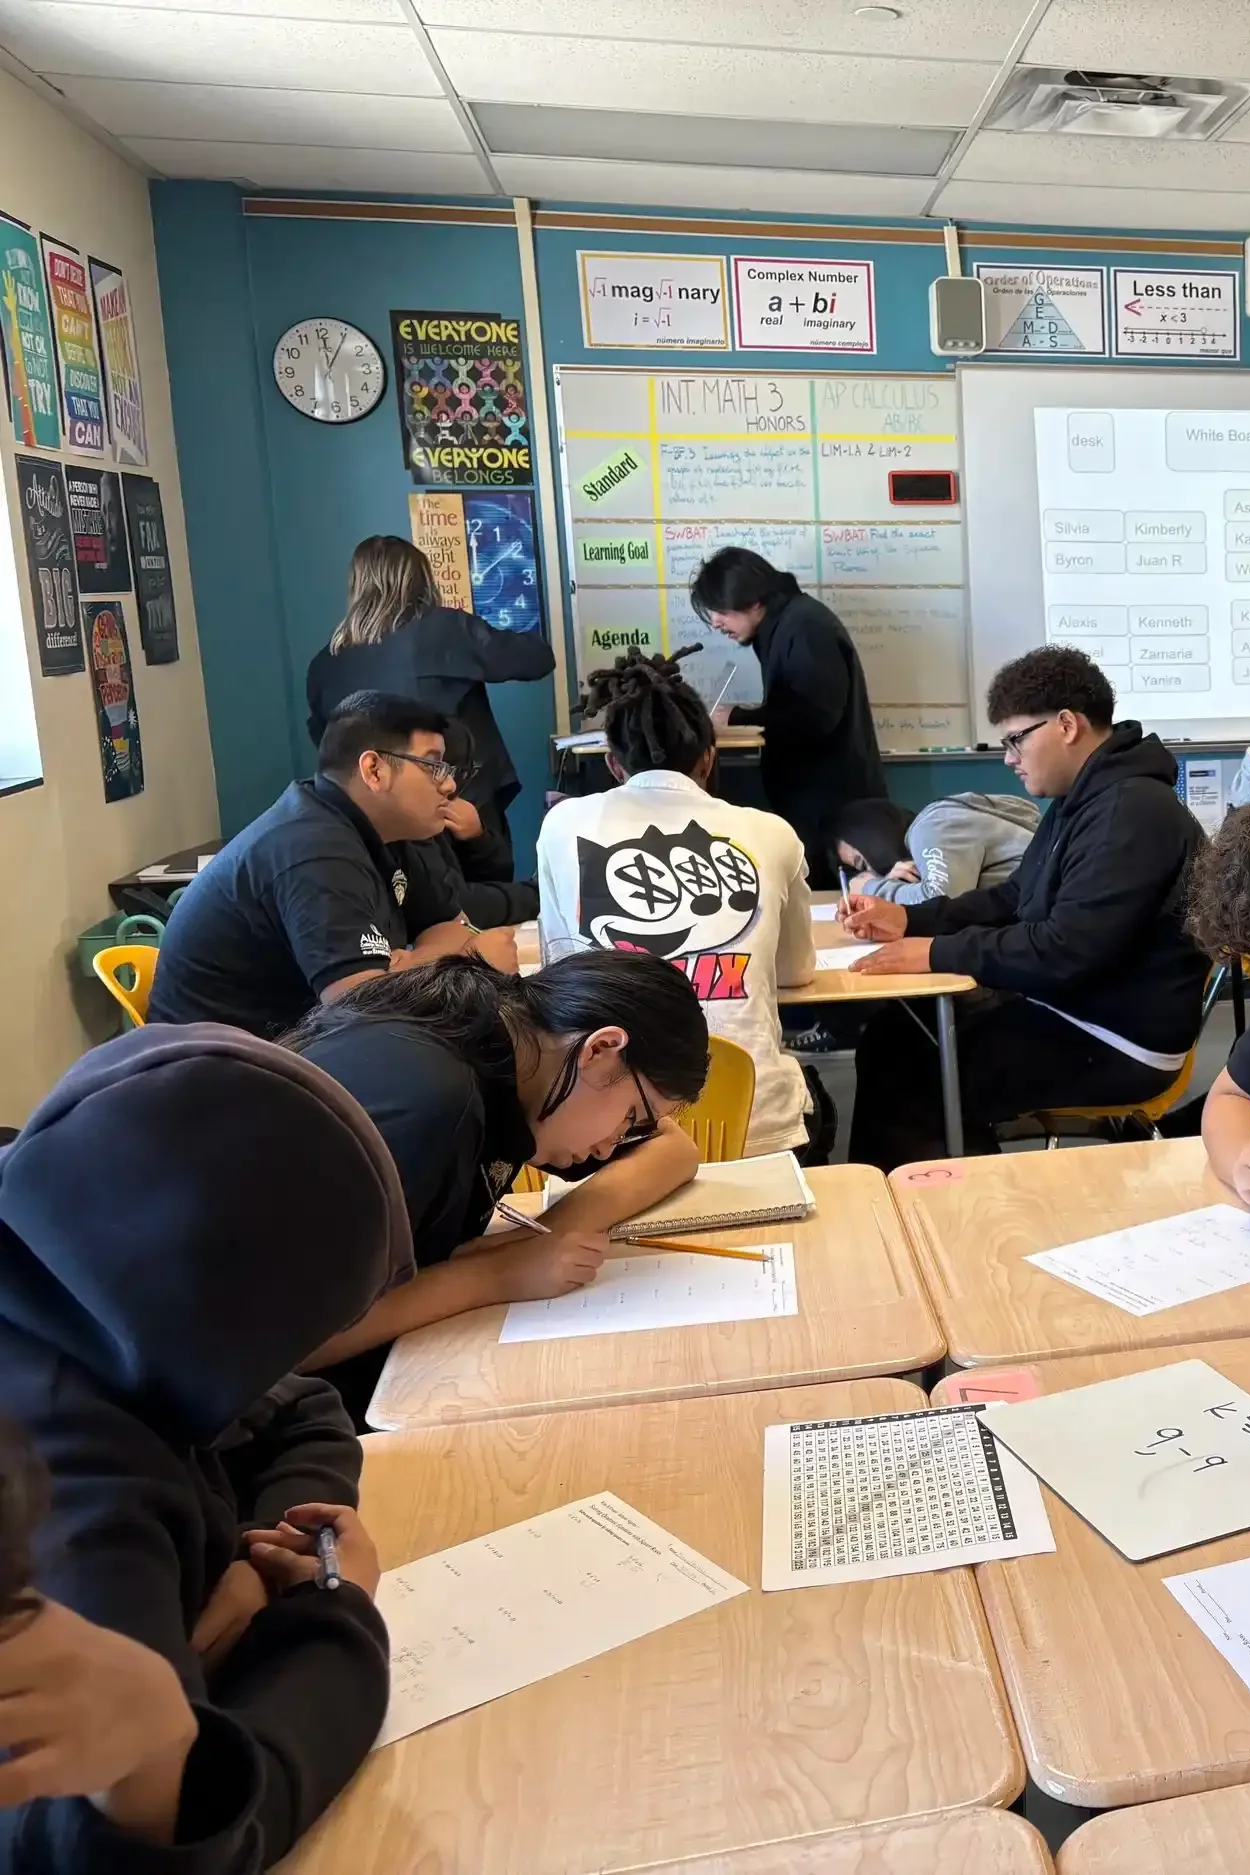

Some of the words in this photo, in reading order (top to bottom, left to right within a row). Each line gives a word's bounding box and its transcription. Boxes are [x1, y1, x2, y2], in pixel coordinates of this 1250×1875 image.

[747, 268, 804, 284] Complex
[808, 271, 859, 284] Number
[984, 274, 1018, 286] Order
[1022, 271, 1034, 286] of
[1036, 270, 1099, 290] Operations
[1133, 280, 1176, 297] Less
[1182, 282, 1221, 299] than
[768, 295, 782, 313] a
[812, 292, 837, 314] bi
[1034, 293, 1045, 306] G
[1036, 307, 1044, 319] E
[1180, 313, 1187, 323] 3
[760, 315, 783, 327] real
[803, 318, 856, 332] imaginary
[315, 328, 329, 340] 12
[400, 320, 519, 343] EVERYONE
[299, 334, 309, 345] 11
[1050, 335, 1057, 348] S
[286, 348, 300, 359] 10
[354, 346, 364, 357] 2
[403, 344, 414, 355] IS
[420, 344, 481, 356] WELCOME
[488, 345, 518, 357] HERE
[285, 367, 295, 378] 9
[362, 364, 372, 375] 3
[69, 369, 97, 393] DISCOVER
[294, 385, 304, 397] 8
[360, 384, 370, 393] 4
[28, 379, 53, 416] TRY
[350, 396, 360, 408] 5
[660, 380, 696, 416] INT.
[703, 380, 759, 415] MATH
[769, 383, 783, 412] 3
[823, 385, 849, 411] AP
[852, 383, 939, 410] CALCULUS
[72, 397, 87, 419] THAT
[331, 402, 341, 413] 6
[746, 415, 806, 432] HONORS
[75, 421, 101, 446] CAN
[1072, 434, 1104, 447] desk
[1186, 429, 1224, 442] White
[412, 447, 530, 469] EVERYONE
[432, 469, 515, 485] BELONGS
[583, 452, 639, 502] Standard
[422, 498, 440, 510] The
[420, 512, 457, 526] time
[466, 519, 482, 535] 12
[493, 526, 501, 542] 1
[1055, 522, 1090, 534] Silvia
[1135, 523, 1192, 537] Kimberly
[418, 535, 461, 549] always
[428, 547, 456, 569] ight
[583, 543, 625, 564] Learning
[628, 541, 649, 560] Goal
[1056, 555, 1093, 569] Byron
[1136, 555, 1168, 567] Juan
[1172, 555, 1182, 566] R
[442, 565, 461, 581] do
[523, 569, 533, 585] 3
[38, 567, 76, 628] BIG
[515, 594, 526, 609] 4
[500, 610, 511, 626] 5
[1058, 616, 1098, 628] Alexis
[1139, 617, 1192, 628] Kenneth
[46, 632, 78, 649] difference!
[592, 628, 650, 650] Agenda
[1141, 675, 1182, 687] Yanira
[794, 1550, 803, 1559] 210
[795, 1560, 803, 1570] 225
